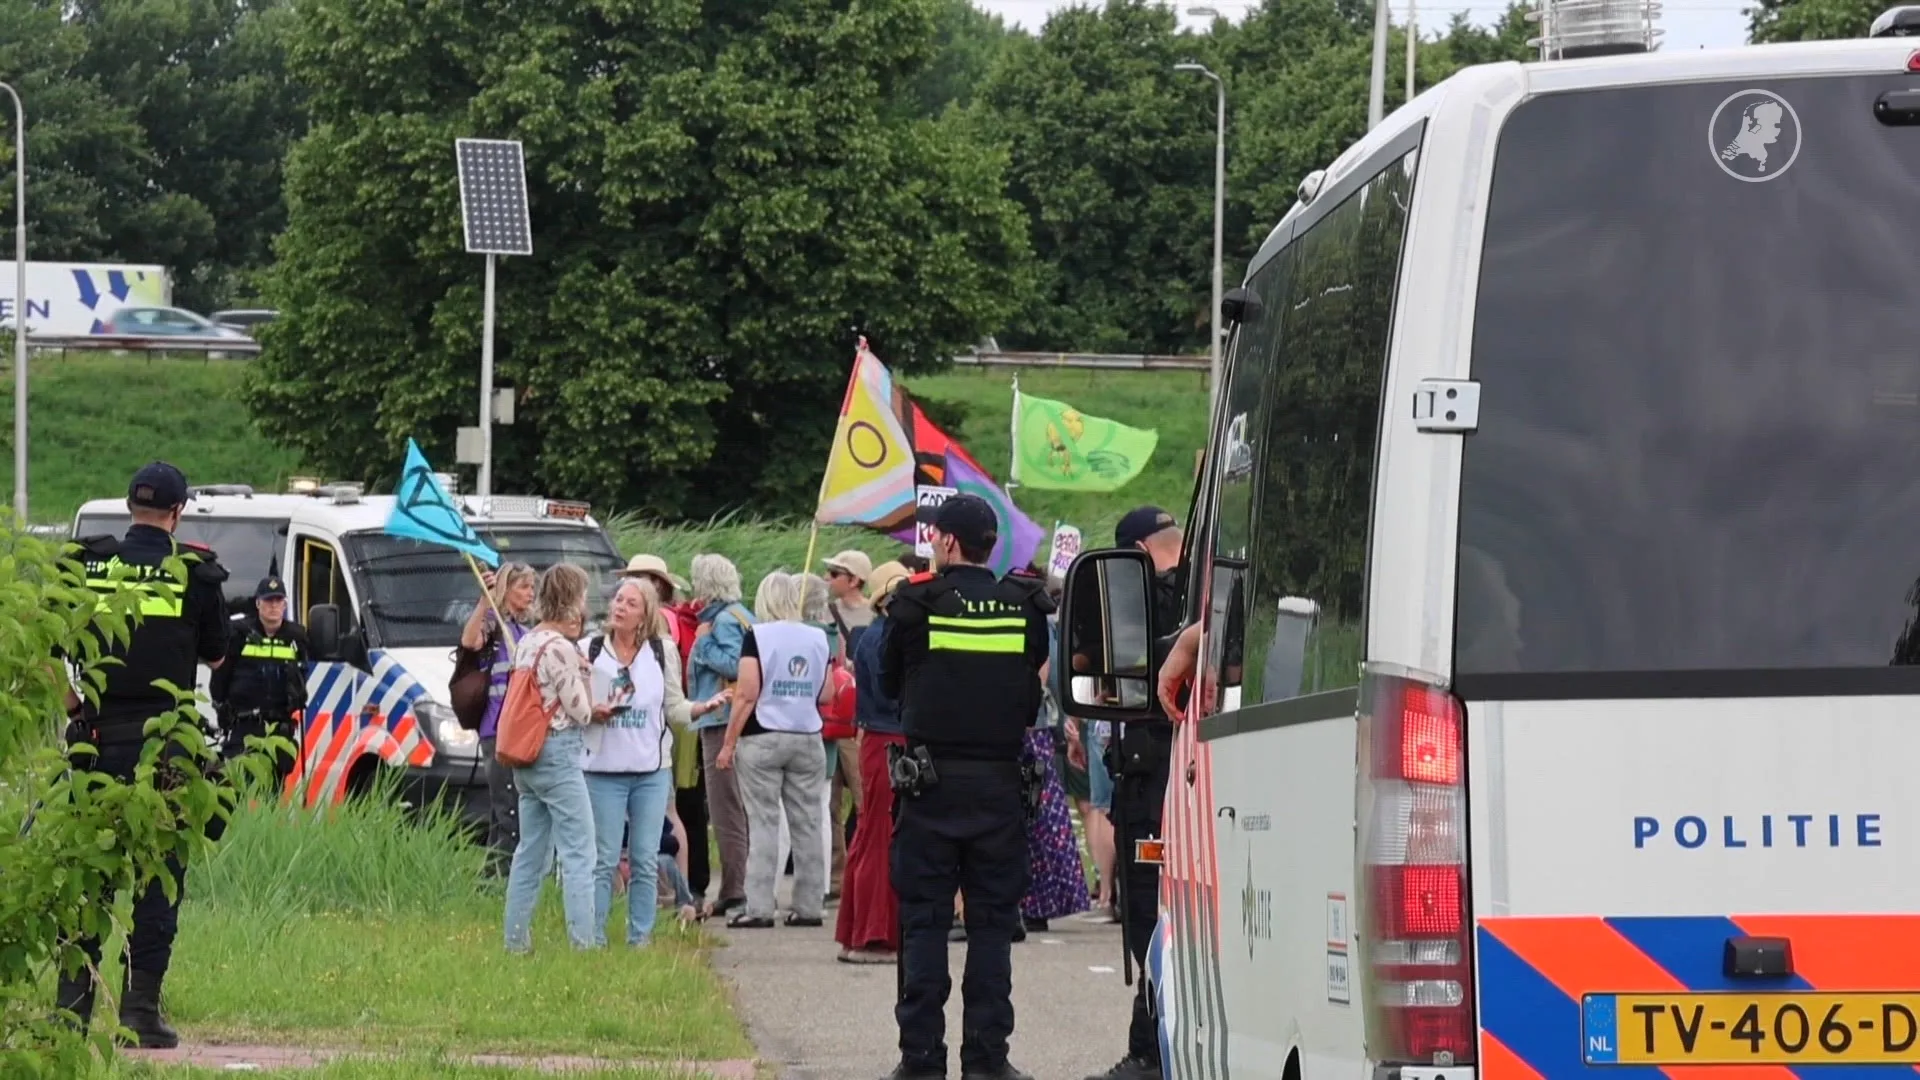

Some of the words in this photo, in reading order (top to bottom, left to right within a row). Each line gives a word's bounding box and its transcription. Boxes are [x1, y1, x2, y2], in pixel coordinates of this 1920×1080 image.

[1634, 814, 1882, 849] POLITIE
[1589, 1037, 1613, 1053] NL
[1632, 1003, 1918, 1055] TV-406-D
